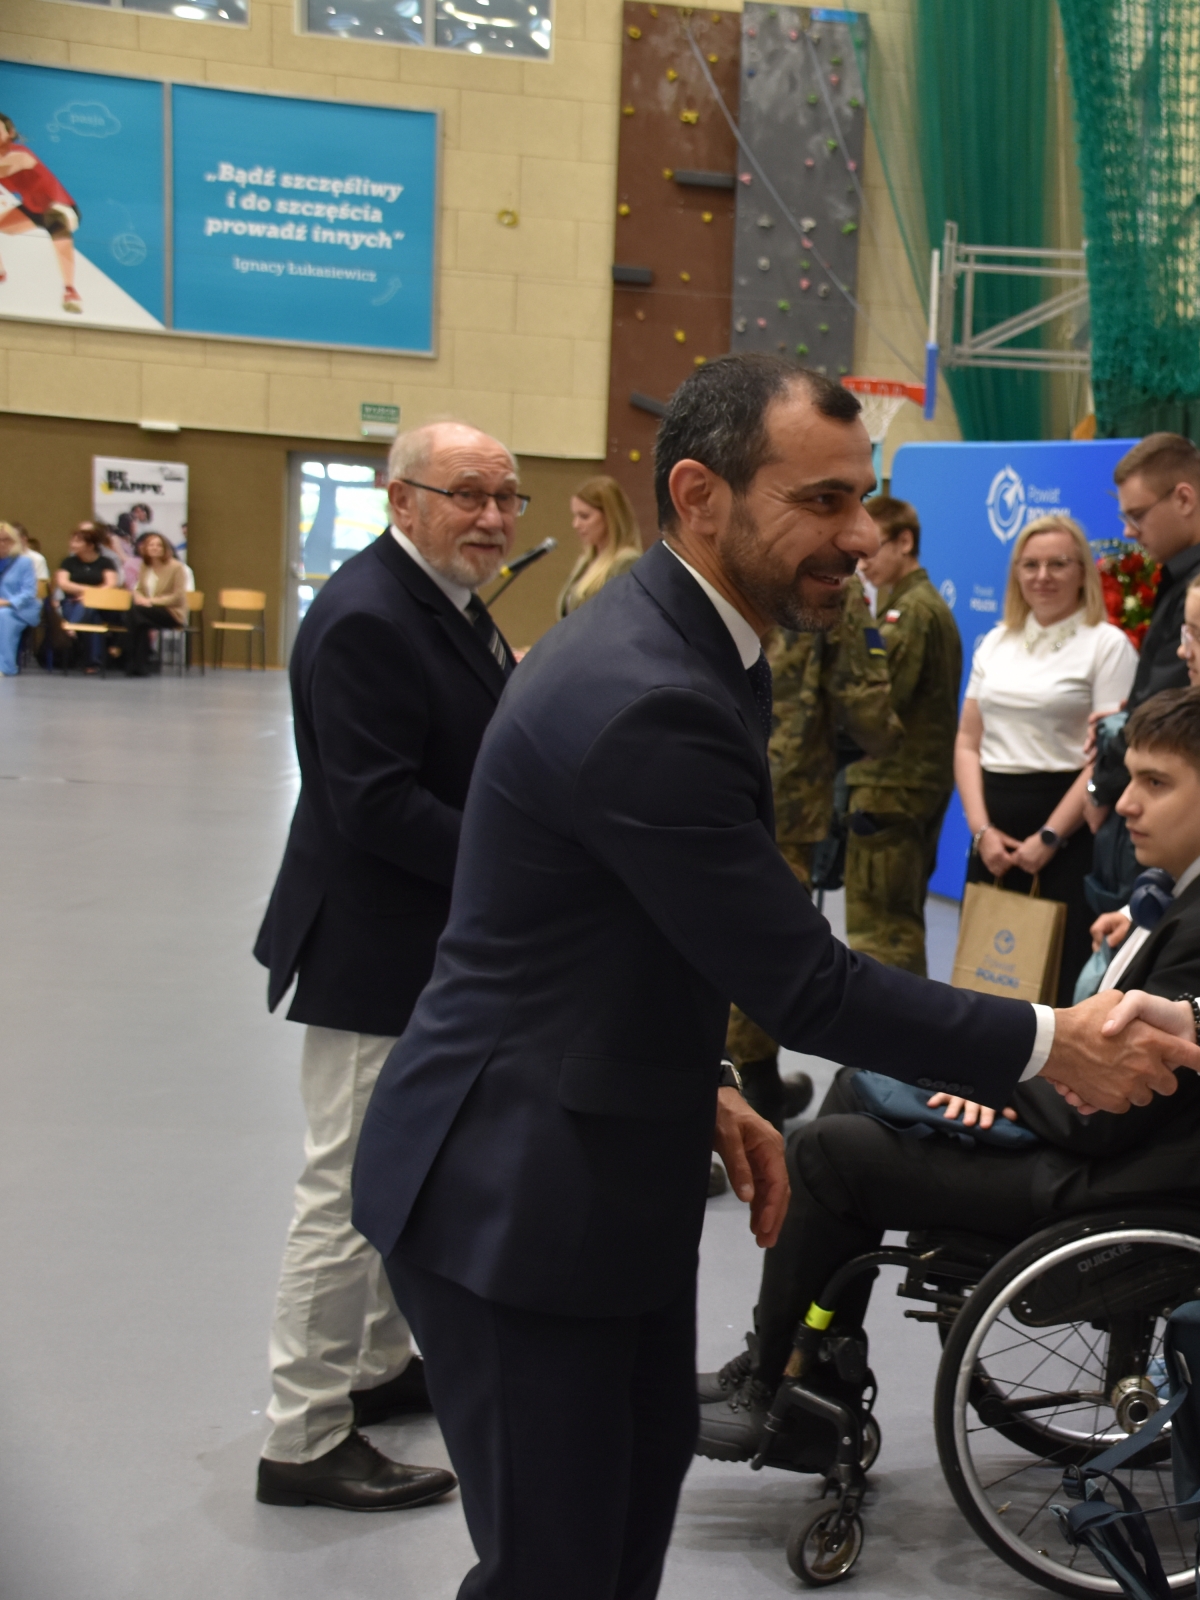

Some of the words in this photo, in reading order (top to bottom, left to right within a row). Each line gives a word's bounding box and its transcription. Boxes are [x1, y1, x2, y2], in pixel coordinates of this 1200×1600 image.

[280, 173, 404, 203] szczęśliwy
[226, 190, 236, 208] i
[240, 192, 271, 212] do
[276, 198, 383, 223] szczęścia
[205, 217, 307, 241] prowadź
[232, 256, 285, 276] Ignacy
[287, 262, 377, 283] Łukasiewicz
[106, 469, 128, 483] BE
[1027, 484, 1061, 504] Powiat
[1077, 1242, 1132, 1272] QUICKIE
